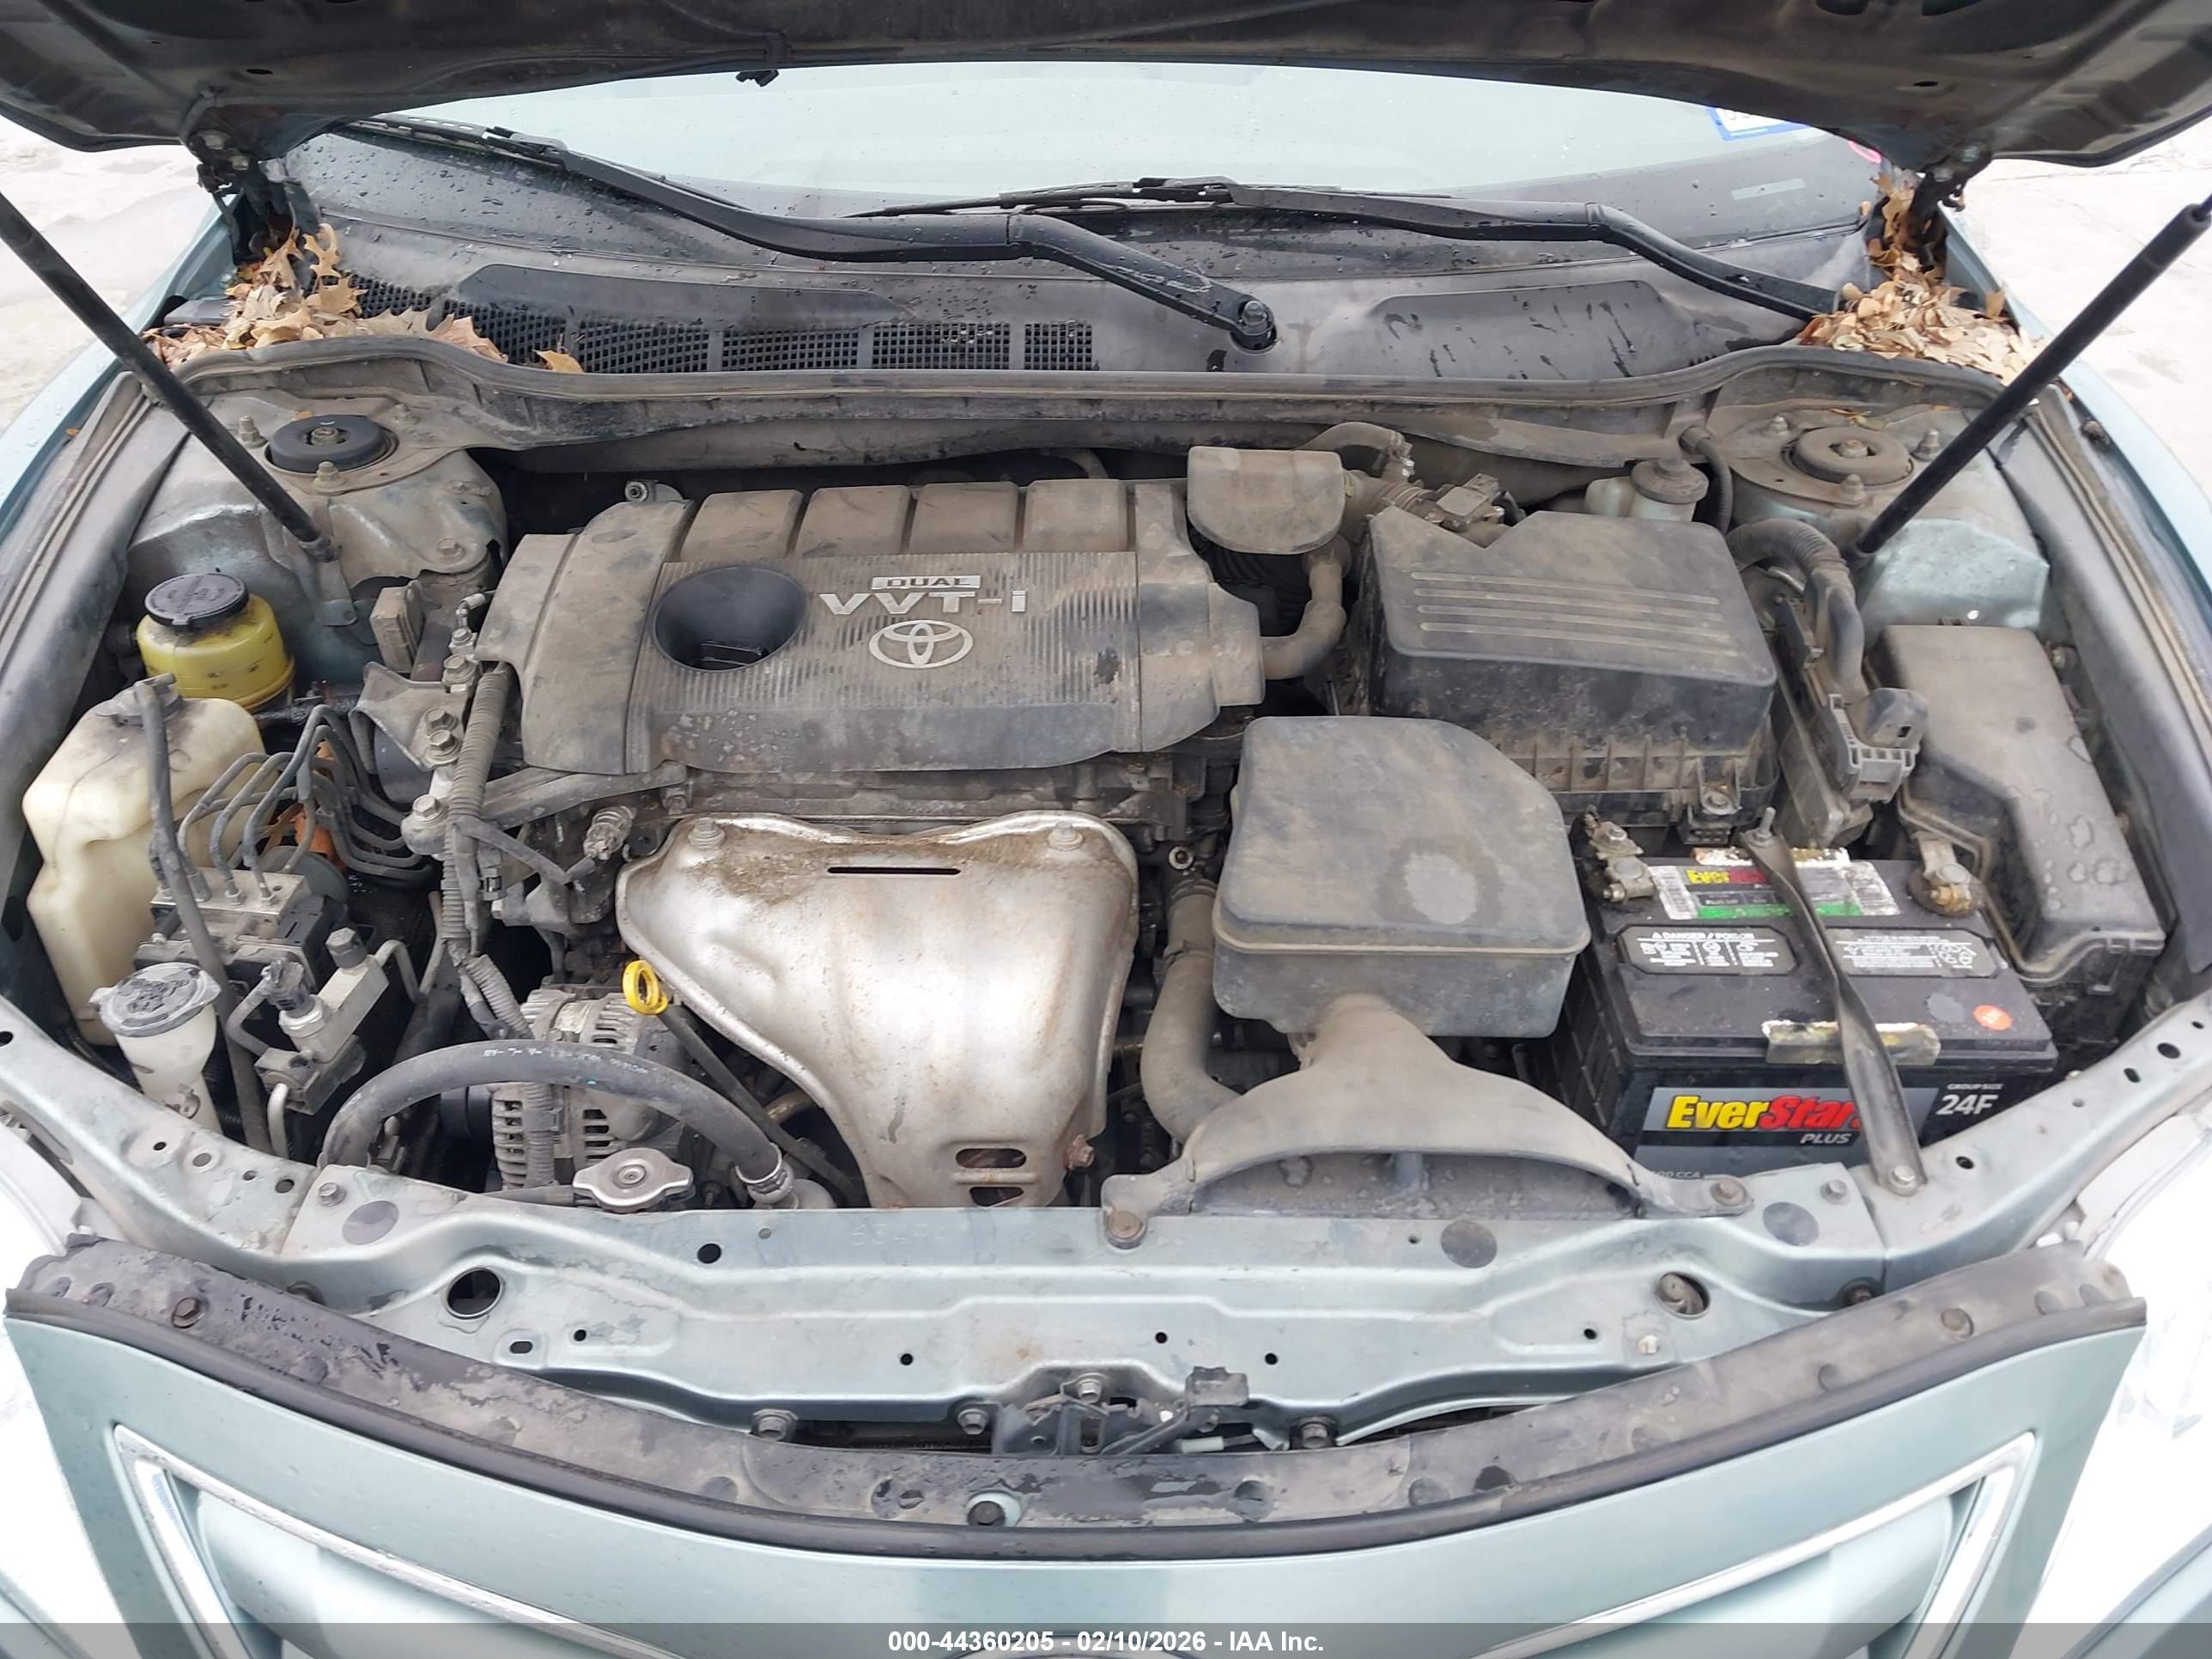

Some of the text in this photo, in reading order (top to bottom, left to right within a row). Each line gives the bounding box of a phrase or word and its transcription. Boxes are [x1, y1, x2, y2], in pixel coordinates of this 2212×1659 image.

[887, 577, 971, 587] DUAL
[818, 590, 1026, 615] VVT-i
[1666, 1095, 1862, 1130] EverStar
[1936, 1093, 1999, 1115] 24F
[1800, 1133, 1851, 1145] PLUS
[1675, 1170, 1702, 1179] CCA
